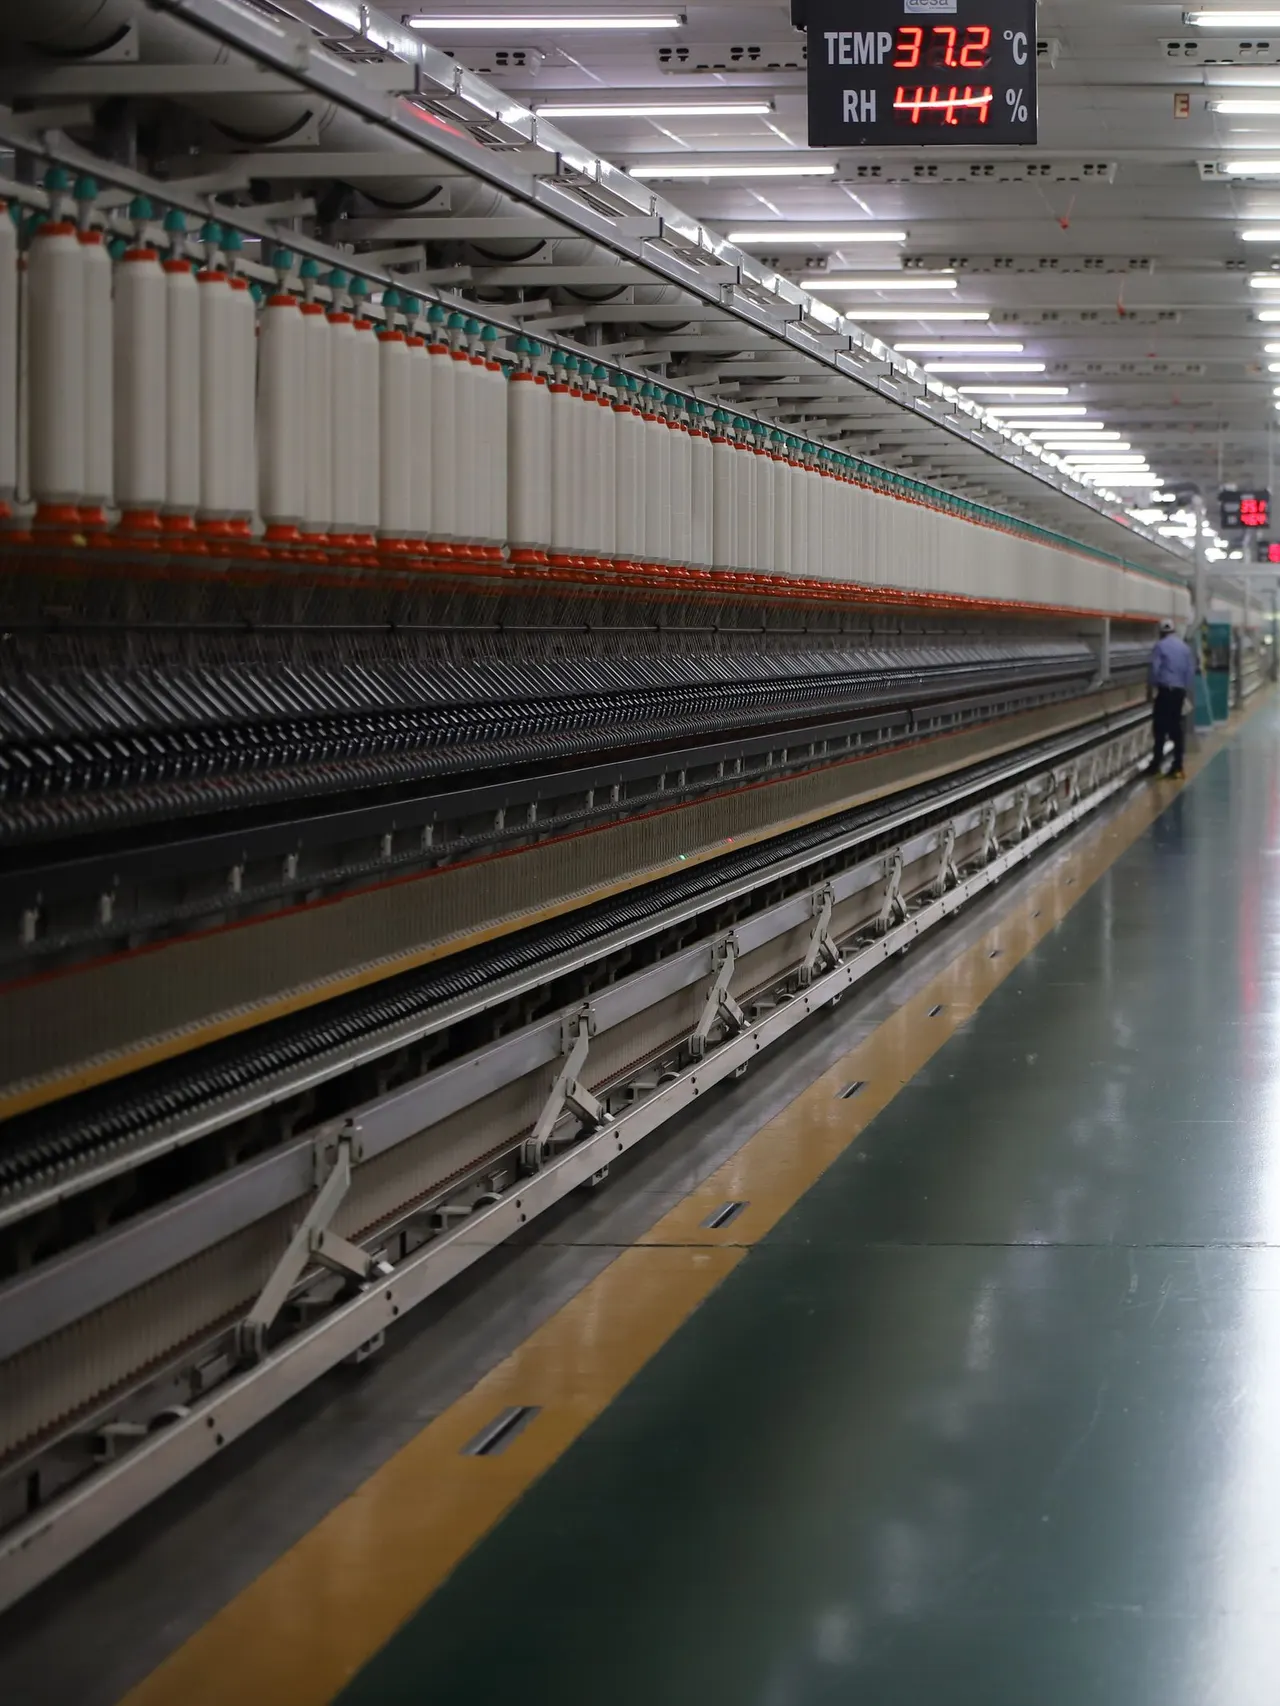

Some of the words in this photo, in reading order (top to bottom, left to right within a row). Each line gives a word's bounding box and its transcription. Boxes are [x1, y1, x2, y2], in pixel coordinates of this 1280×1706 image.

[824, 31, 893, 65] TEMP
[893, 26, 992, 68] 37.2
[1003, 30, 1028, 66] °C
[843, 89, 877, 123] RH
[1005, 88, 1029, 123] %
